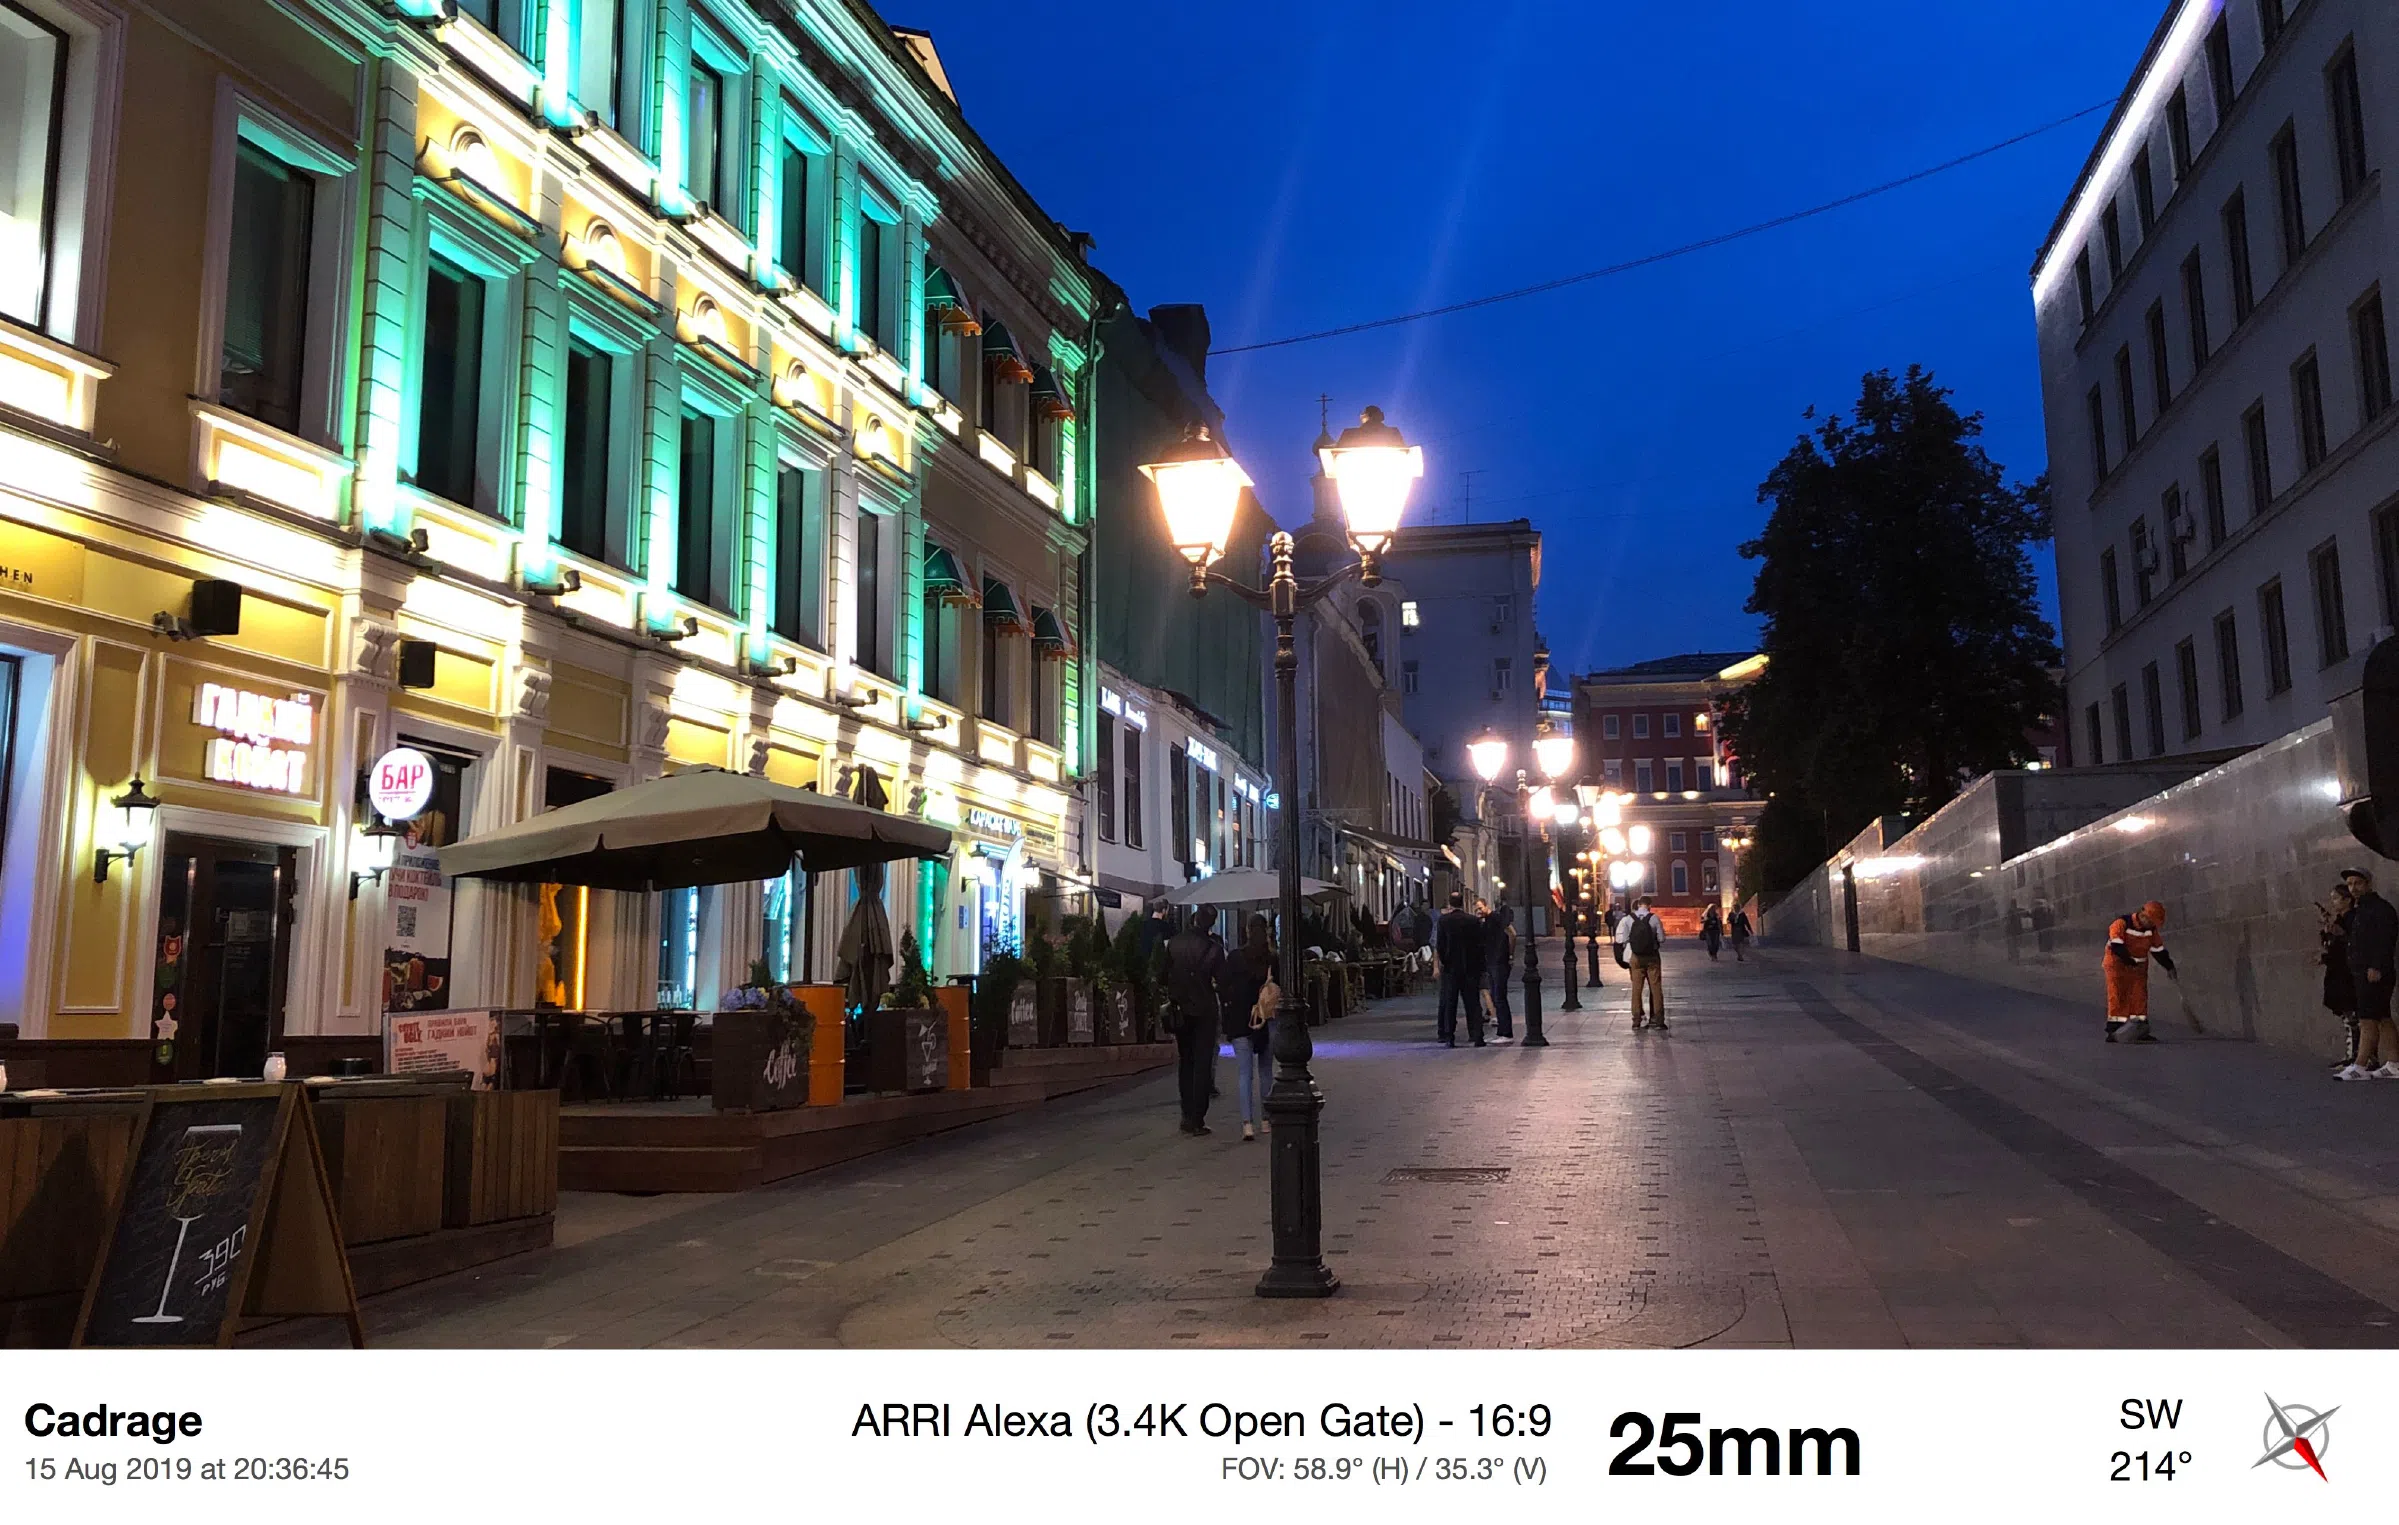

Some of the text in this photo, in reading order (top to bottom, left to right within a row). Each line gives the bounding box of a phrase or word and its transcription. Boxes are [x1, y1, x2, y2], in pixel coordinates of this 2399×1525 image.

[381, 764, 424, 790] БАР
[764, 1044, 796, 1090] Coffee
[194, 1224, 246, 1285] 390
